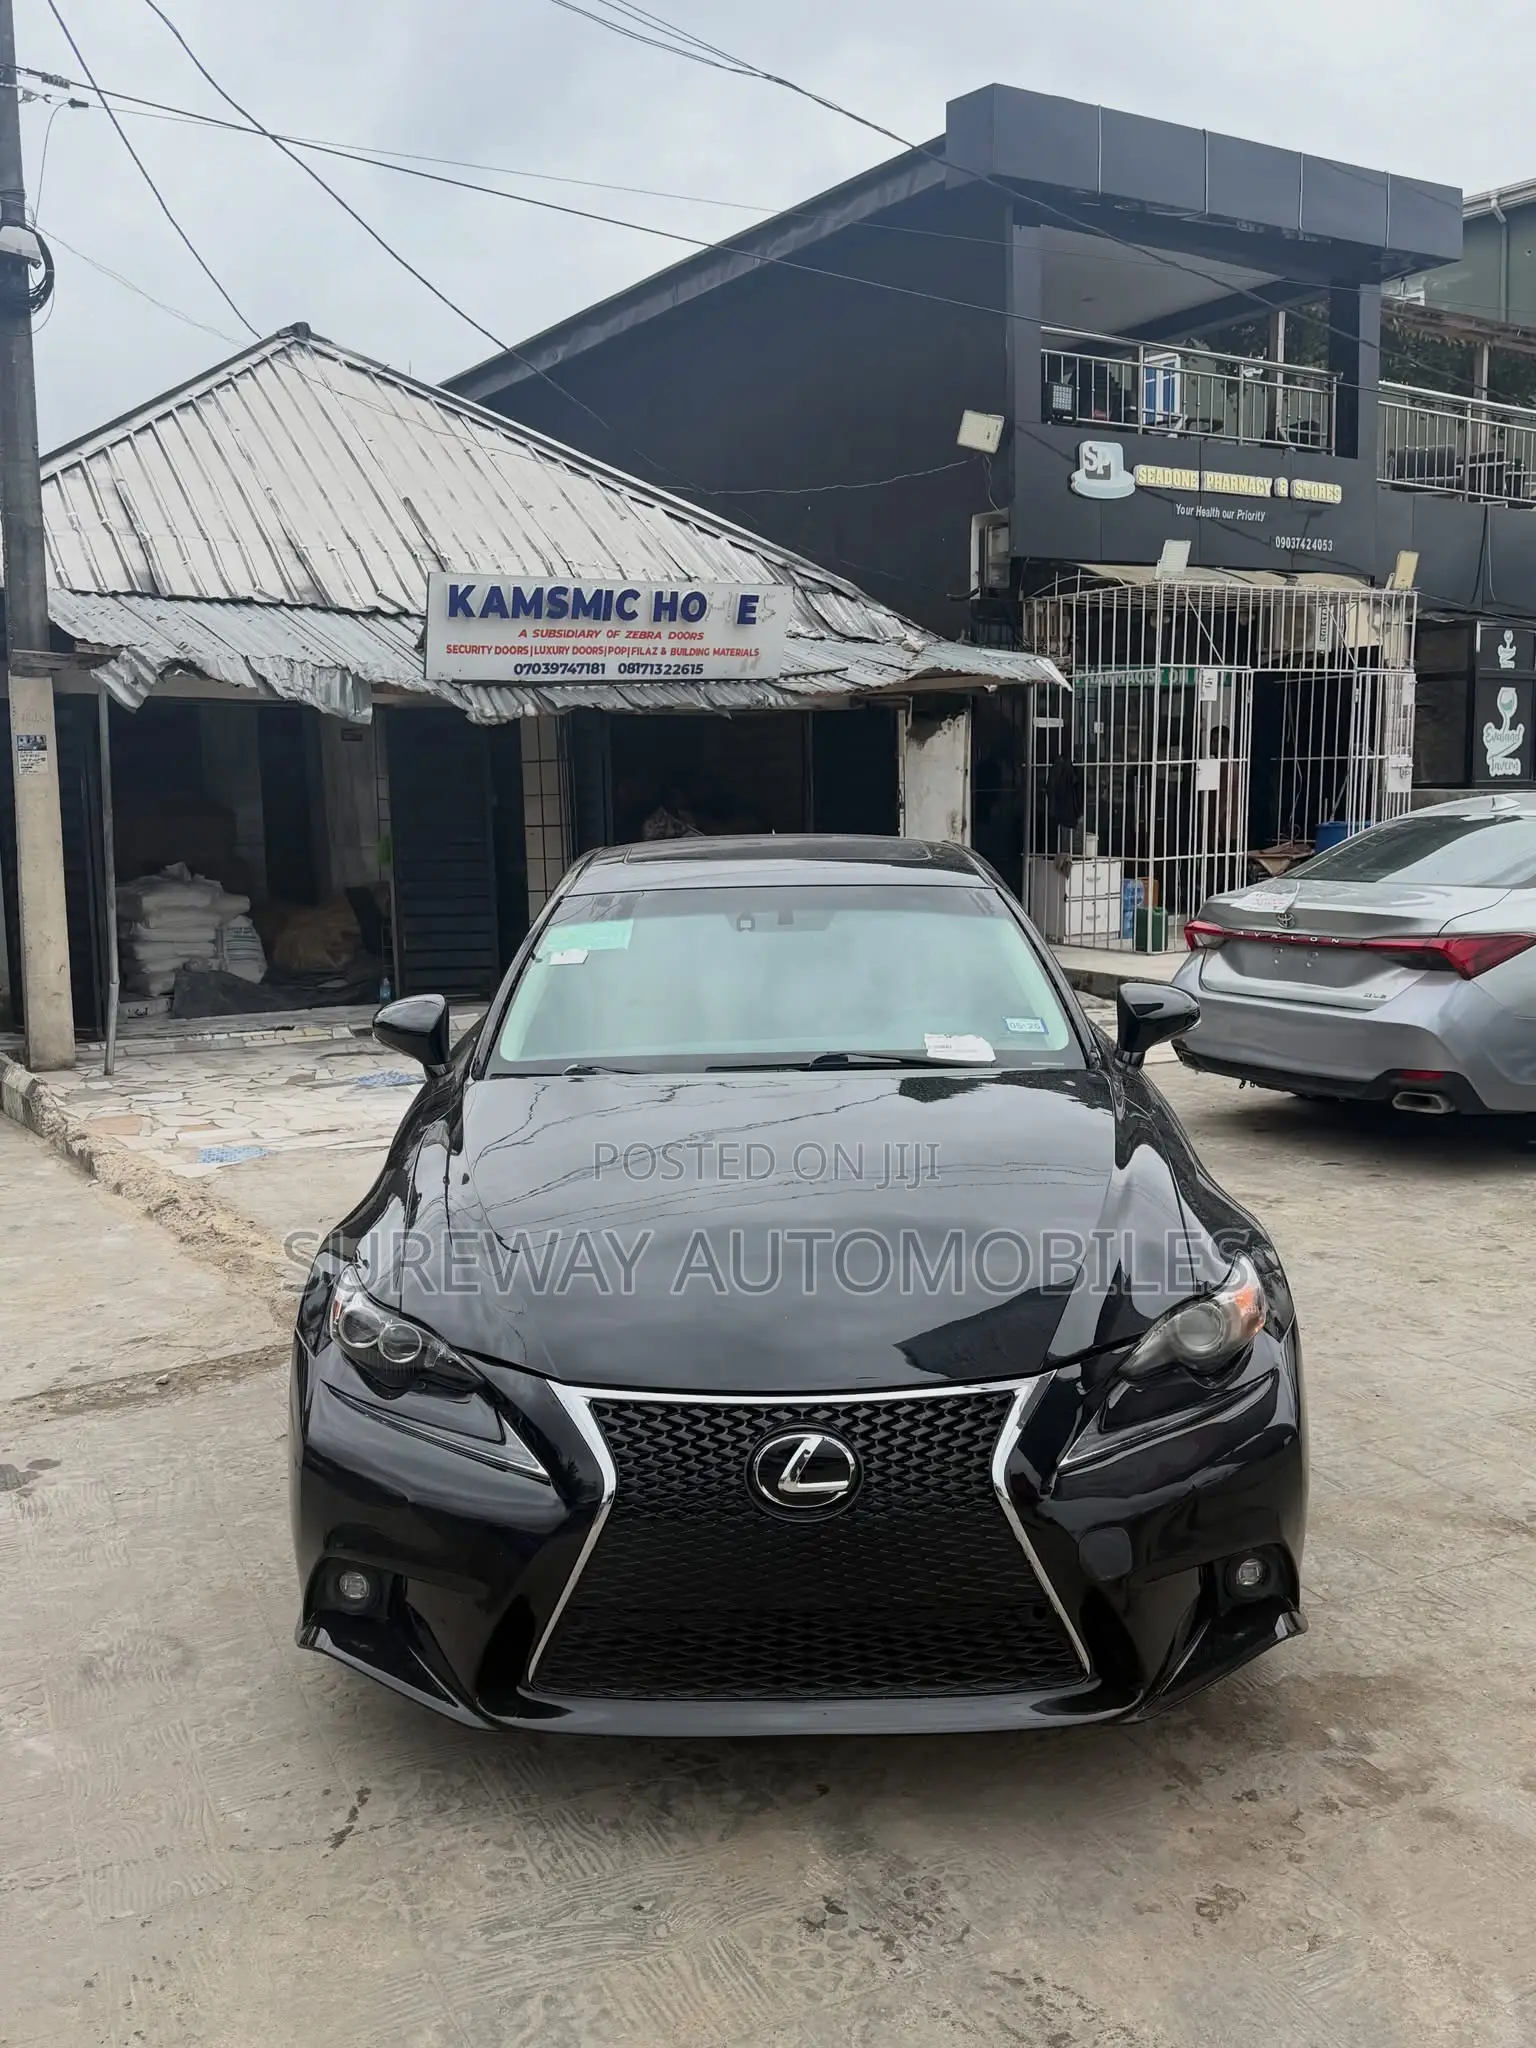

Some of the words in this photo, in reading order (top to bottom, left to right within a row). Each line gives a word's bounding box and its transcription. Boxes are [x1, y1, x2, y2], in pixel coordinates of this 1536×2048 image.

[1138, 467, 1198, 490] SEADONE
[1206, 474, 1272, 497] PHARMACY
[1295, 481, 1341, 502] STORES
[1175, 504, 1194, 516] Your
[1196, 506, 1220, 518] Health
[1222, 510, 1235, 519] our
[1237, 510, 1265, 522] Priority
[1275, 536, 1333, 552] 09037424053
[448, 584, 641, 621] KAMSMIC
[518, 629, 527, 638] A
[532, 629, 601, 639] SUBSIDIARY
[606, 630, 621, 639] OF
[625, 631, 662, 640] ZEBRA
[668, 631, 704, 640] DOORS
[446, 644, 492, 655] SECURITY
[660, 647, 667, 656] &
[670, 647, 710, 656] BUILDING
[713, 648, 760, 657] MATERIALS
[513, 663, 605, 675] 07039747181
[618, 662, 704, 675] 08171322615
[1236, 930, 1339, 943] AVALON
